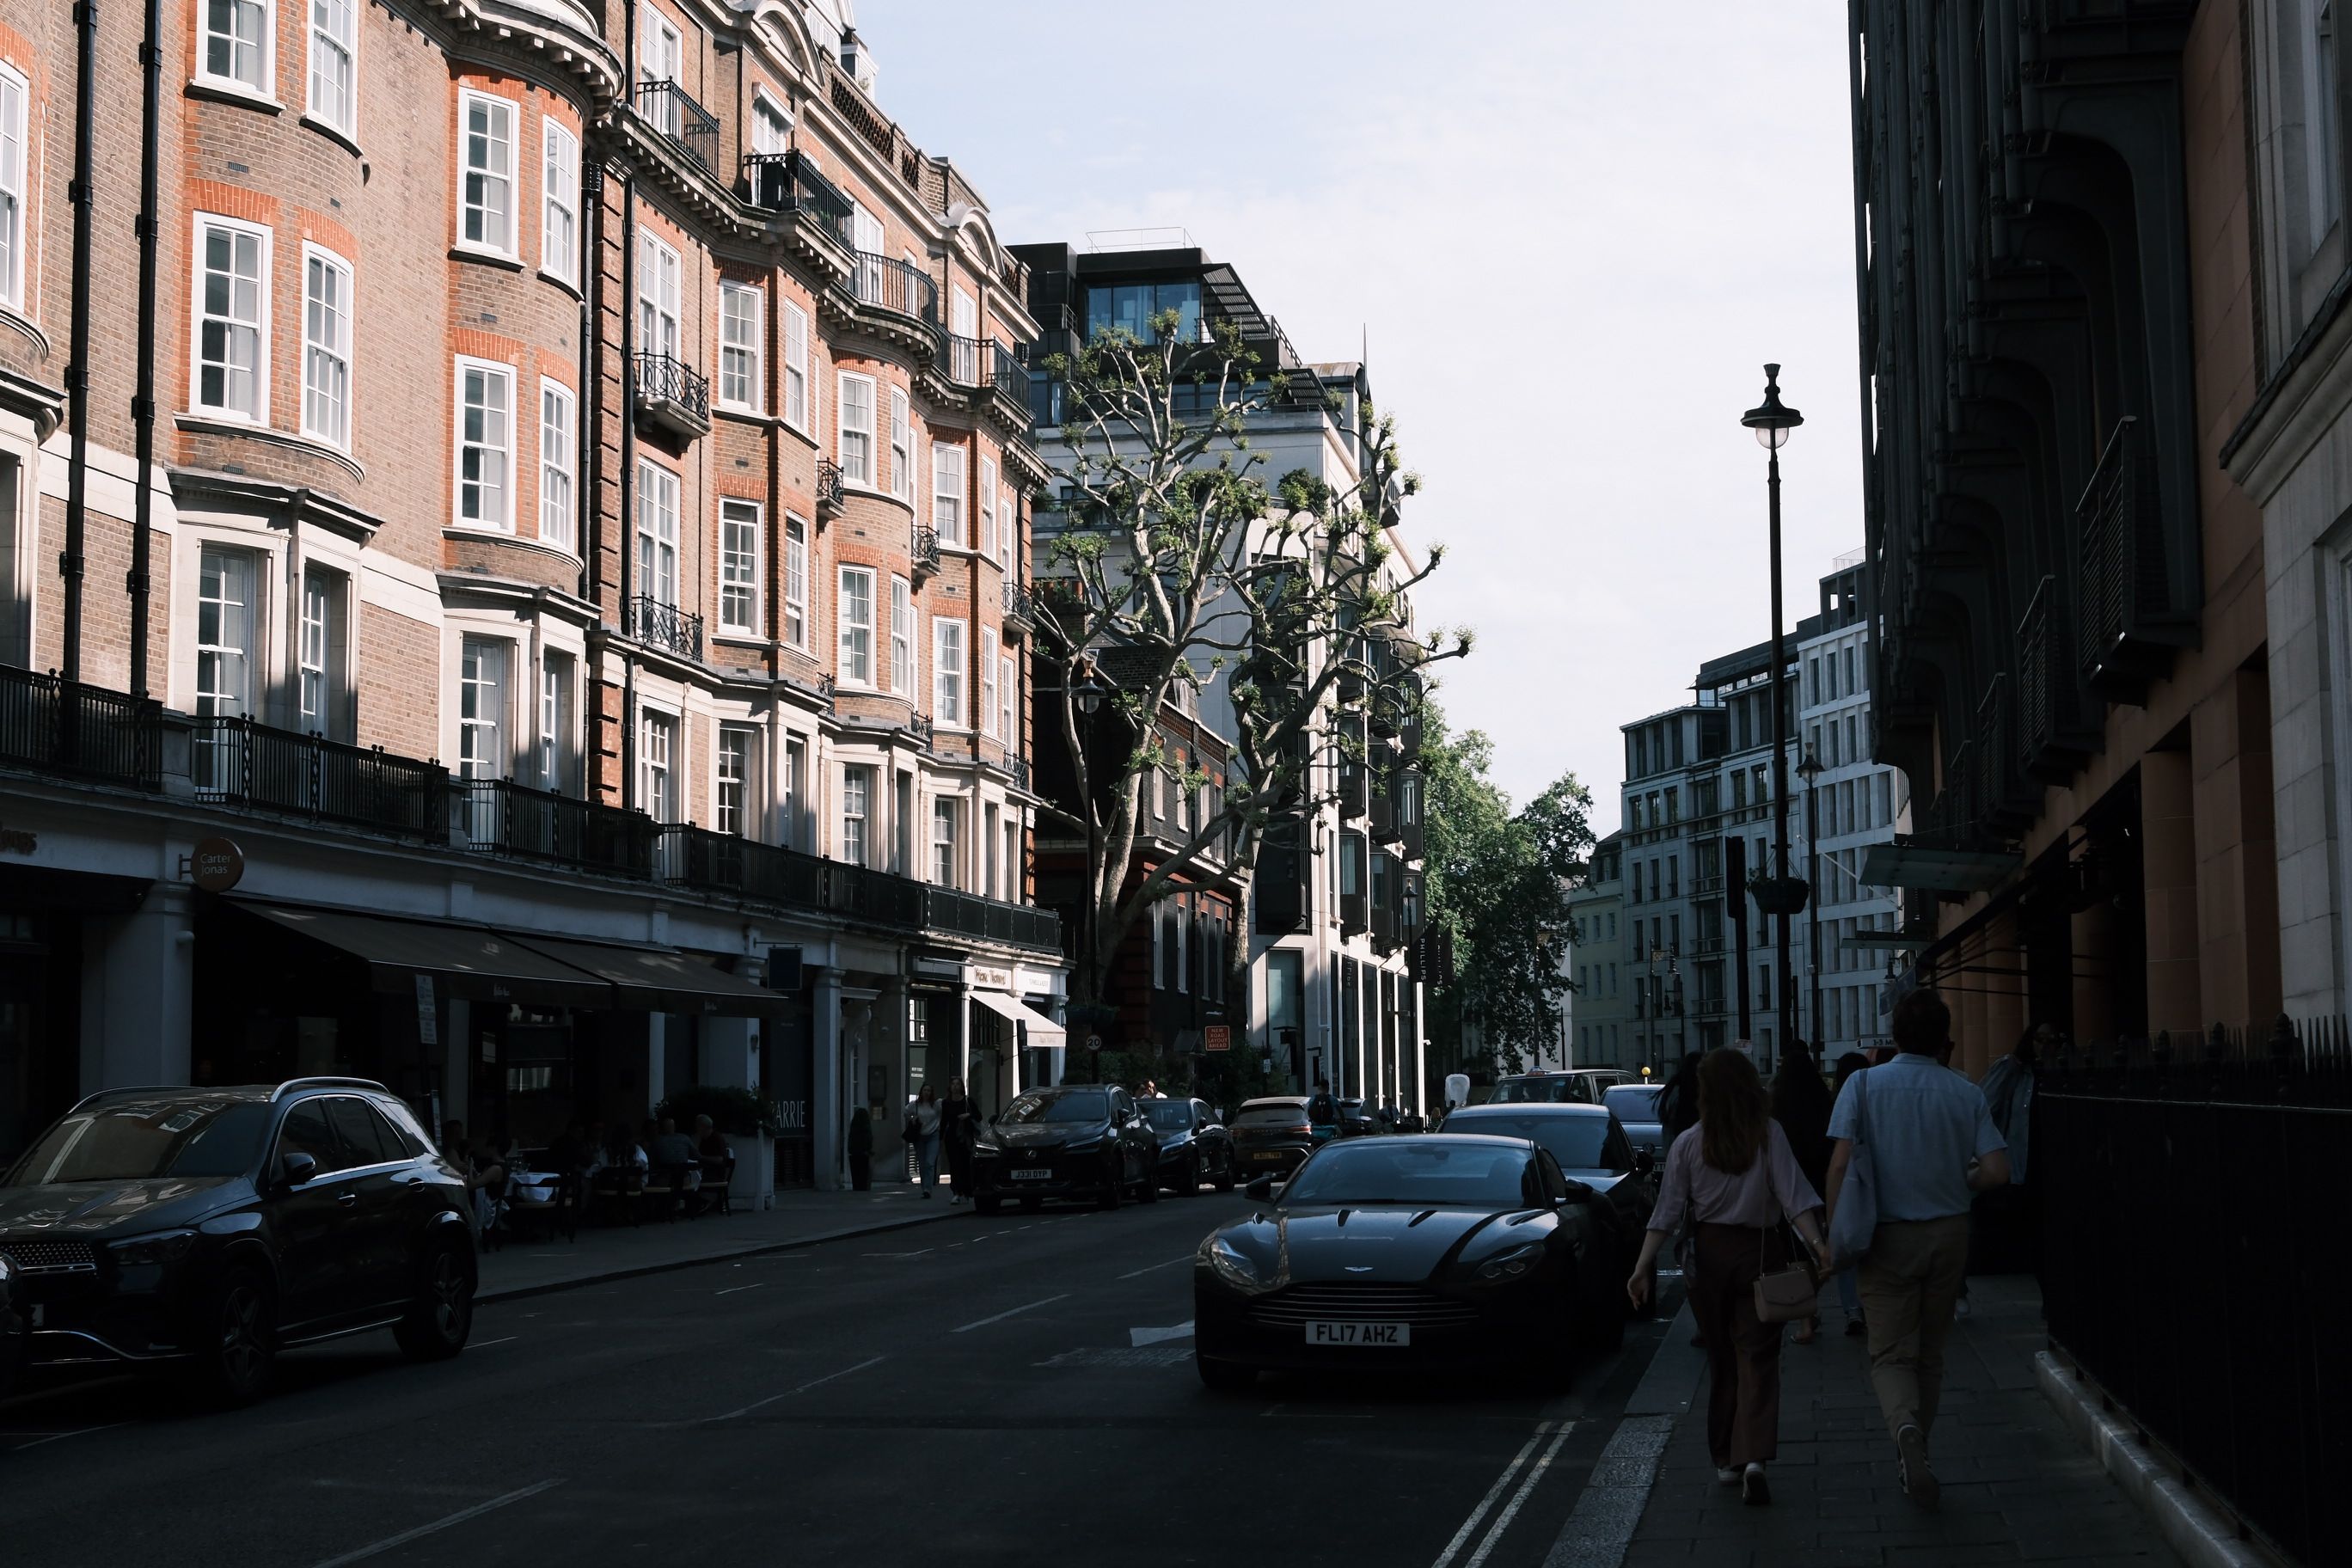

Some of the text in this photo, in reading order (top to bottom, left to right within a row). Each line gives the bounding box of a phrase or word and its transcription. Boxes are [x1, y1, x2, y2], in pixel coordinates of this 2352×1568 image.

[199, 853, 231, 864] Carter
[200, 865, 228, 877] Jonas
[1317, 1325, 1398, 1343] FL17 AHZ
